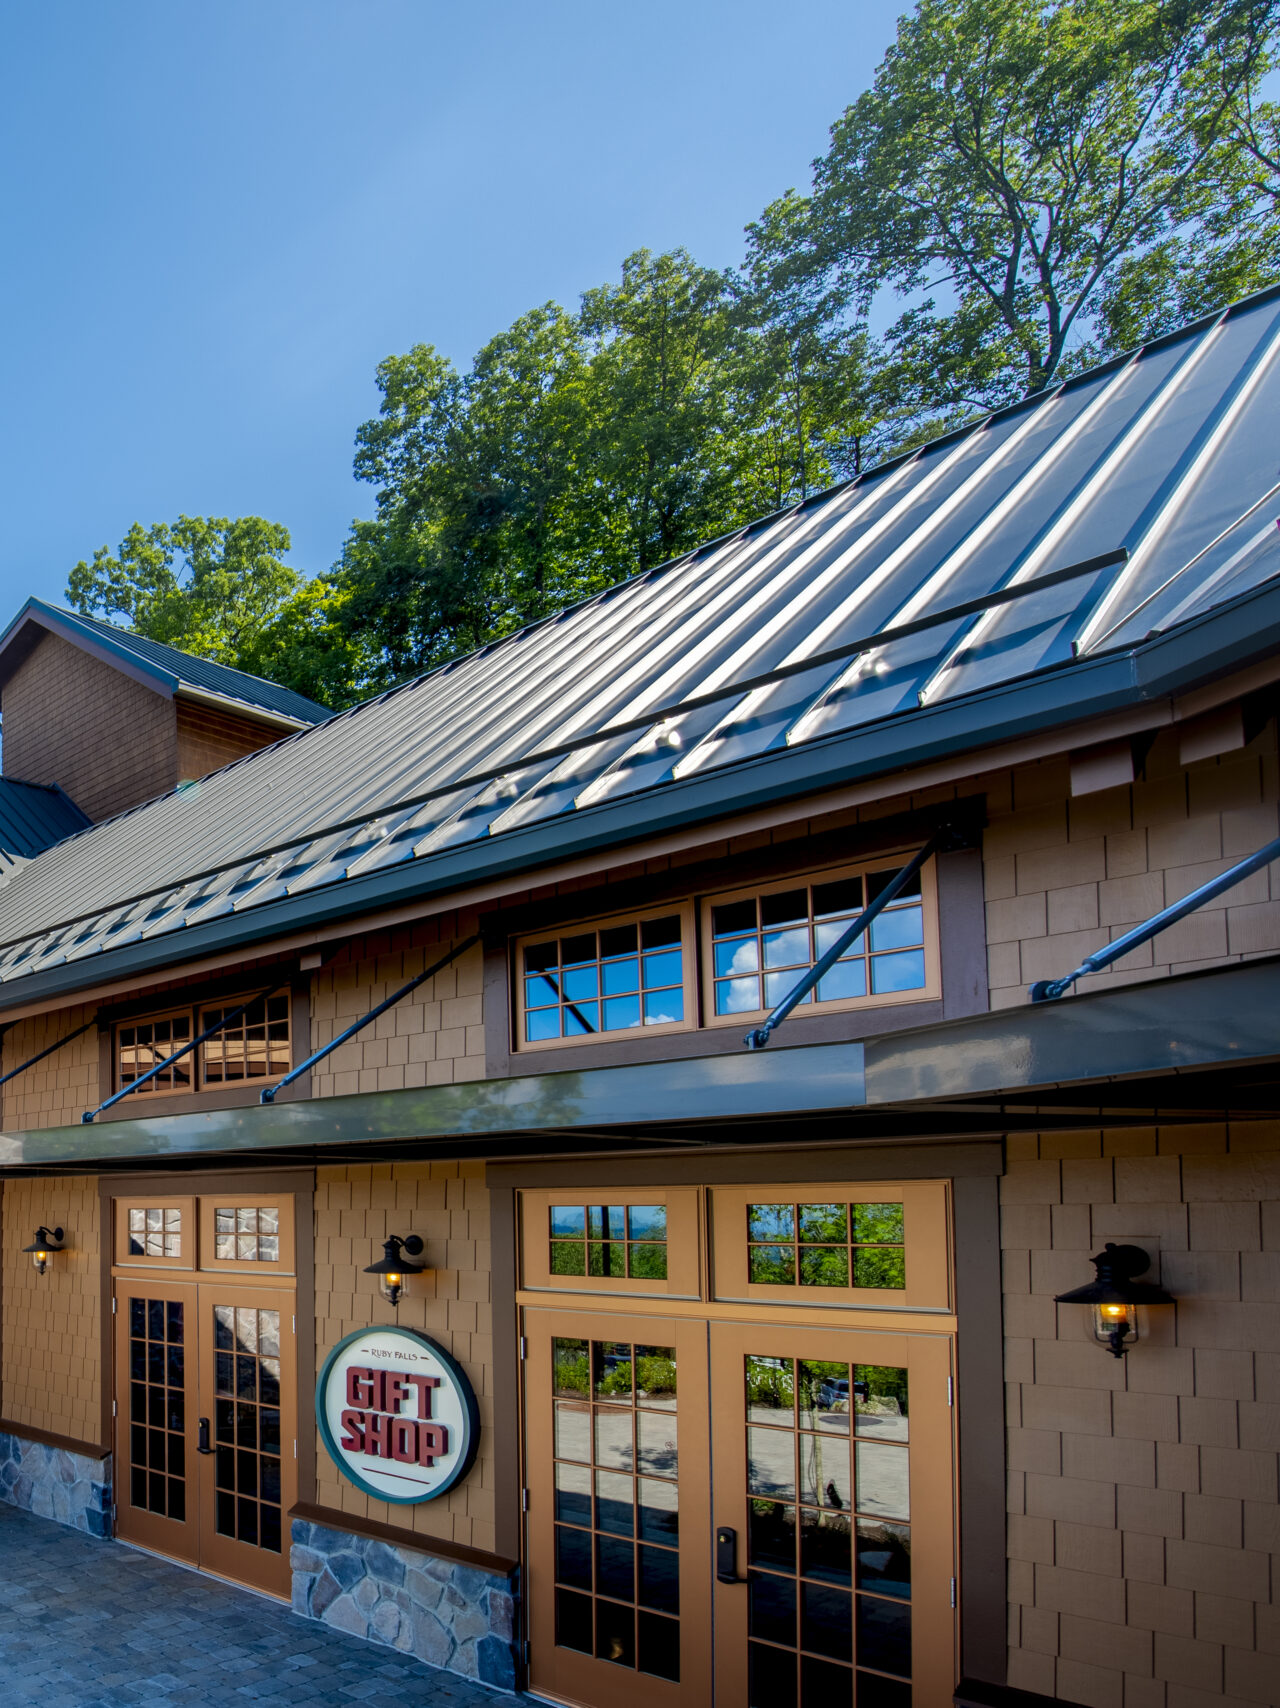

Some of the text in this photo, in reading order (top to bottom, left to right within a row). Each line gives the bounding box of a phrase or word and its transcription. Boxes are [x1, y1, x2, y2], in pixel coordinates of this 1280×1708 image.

[371, 1349, 418, 1361] RUBY FALLS
[346, 1366, 440, 1420] GIFT
[340, 1409, 449, 1468] SHOP
